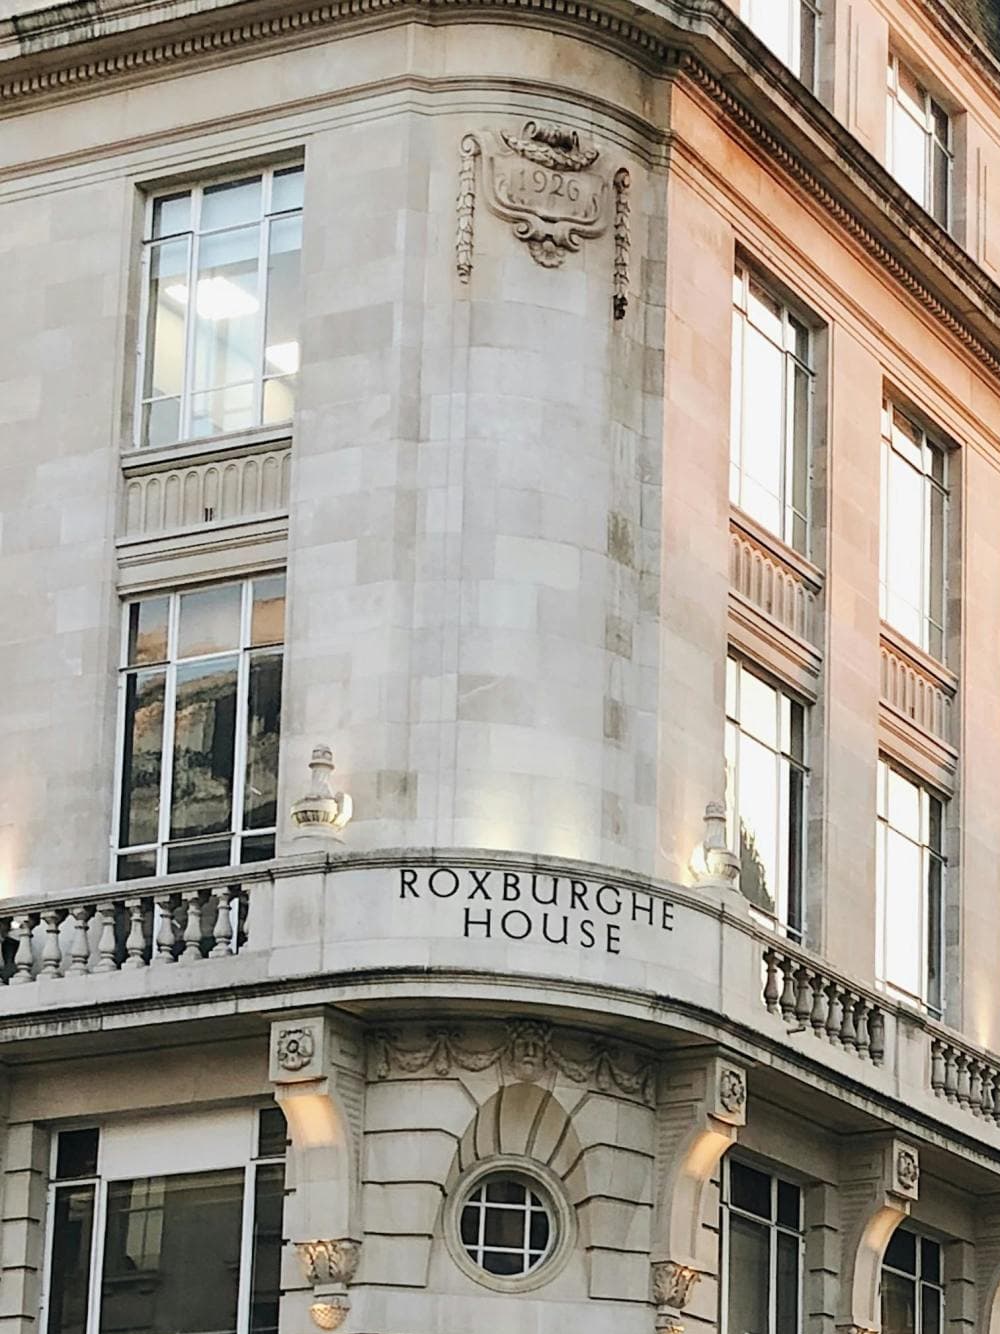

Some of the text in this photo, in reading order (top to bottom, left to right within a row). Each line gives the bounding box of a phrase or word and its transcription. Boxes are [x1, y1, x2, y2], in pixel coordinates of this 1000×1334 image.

[519, 168, 580, 201] 1926
[399, 868, 674, 931] ROXBURGHE
[463, 907, 621, 954] HOUSE
